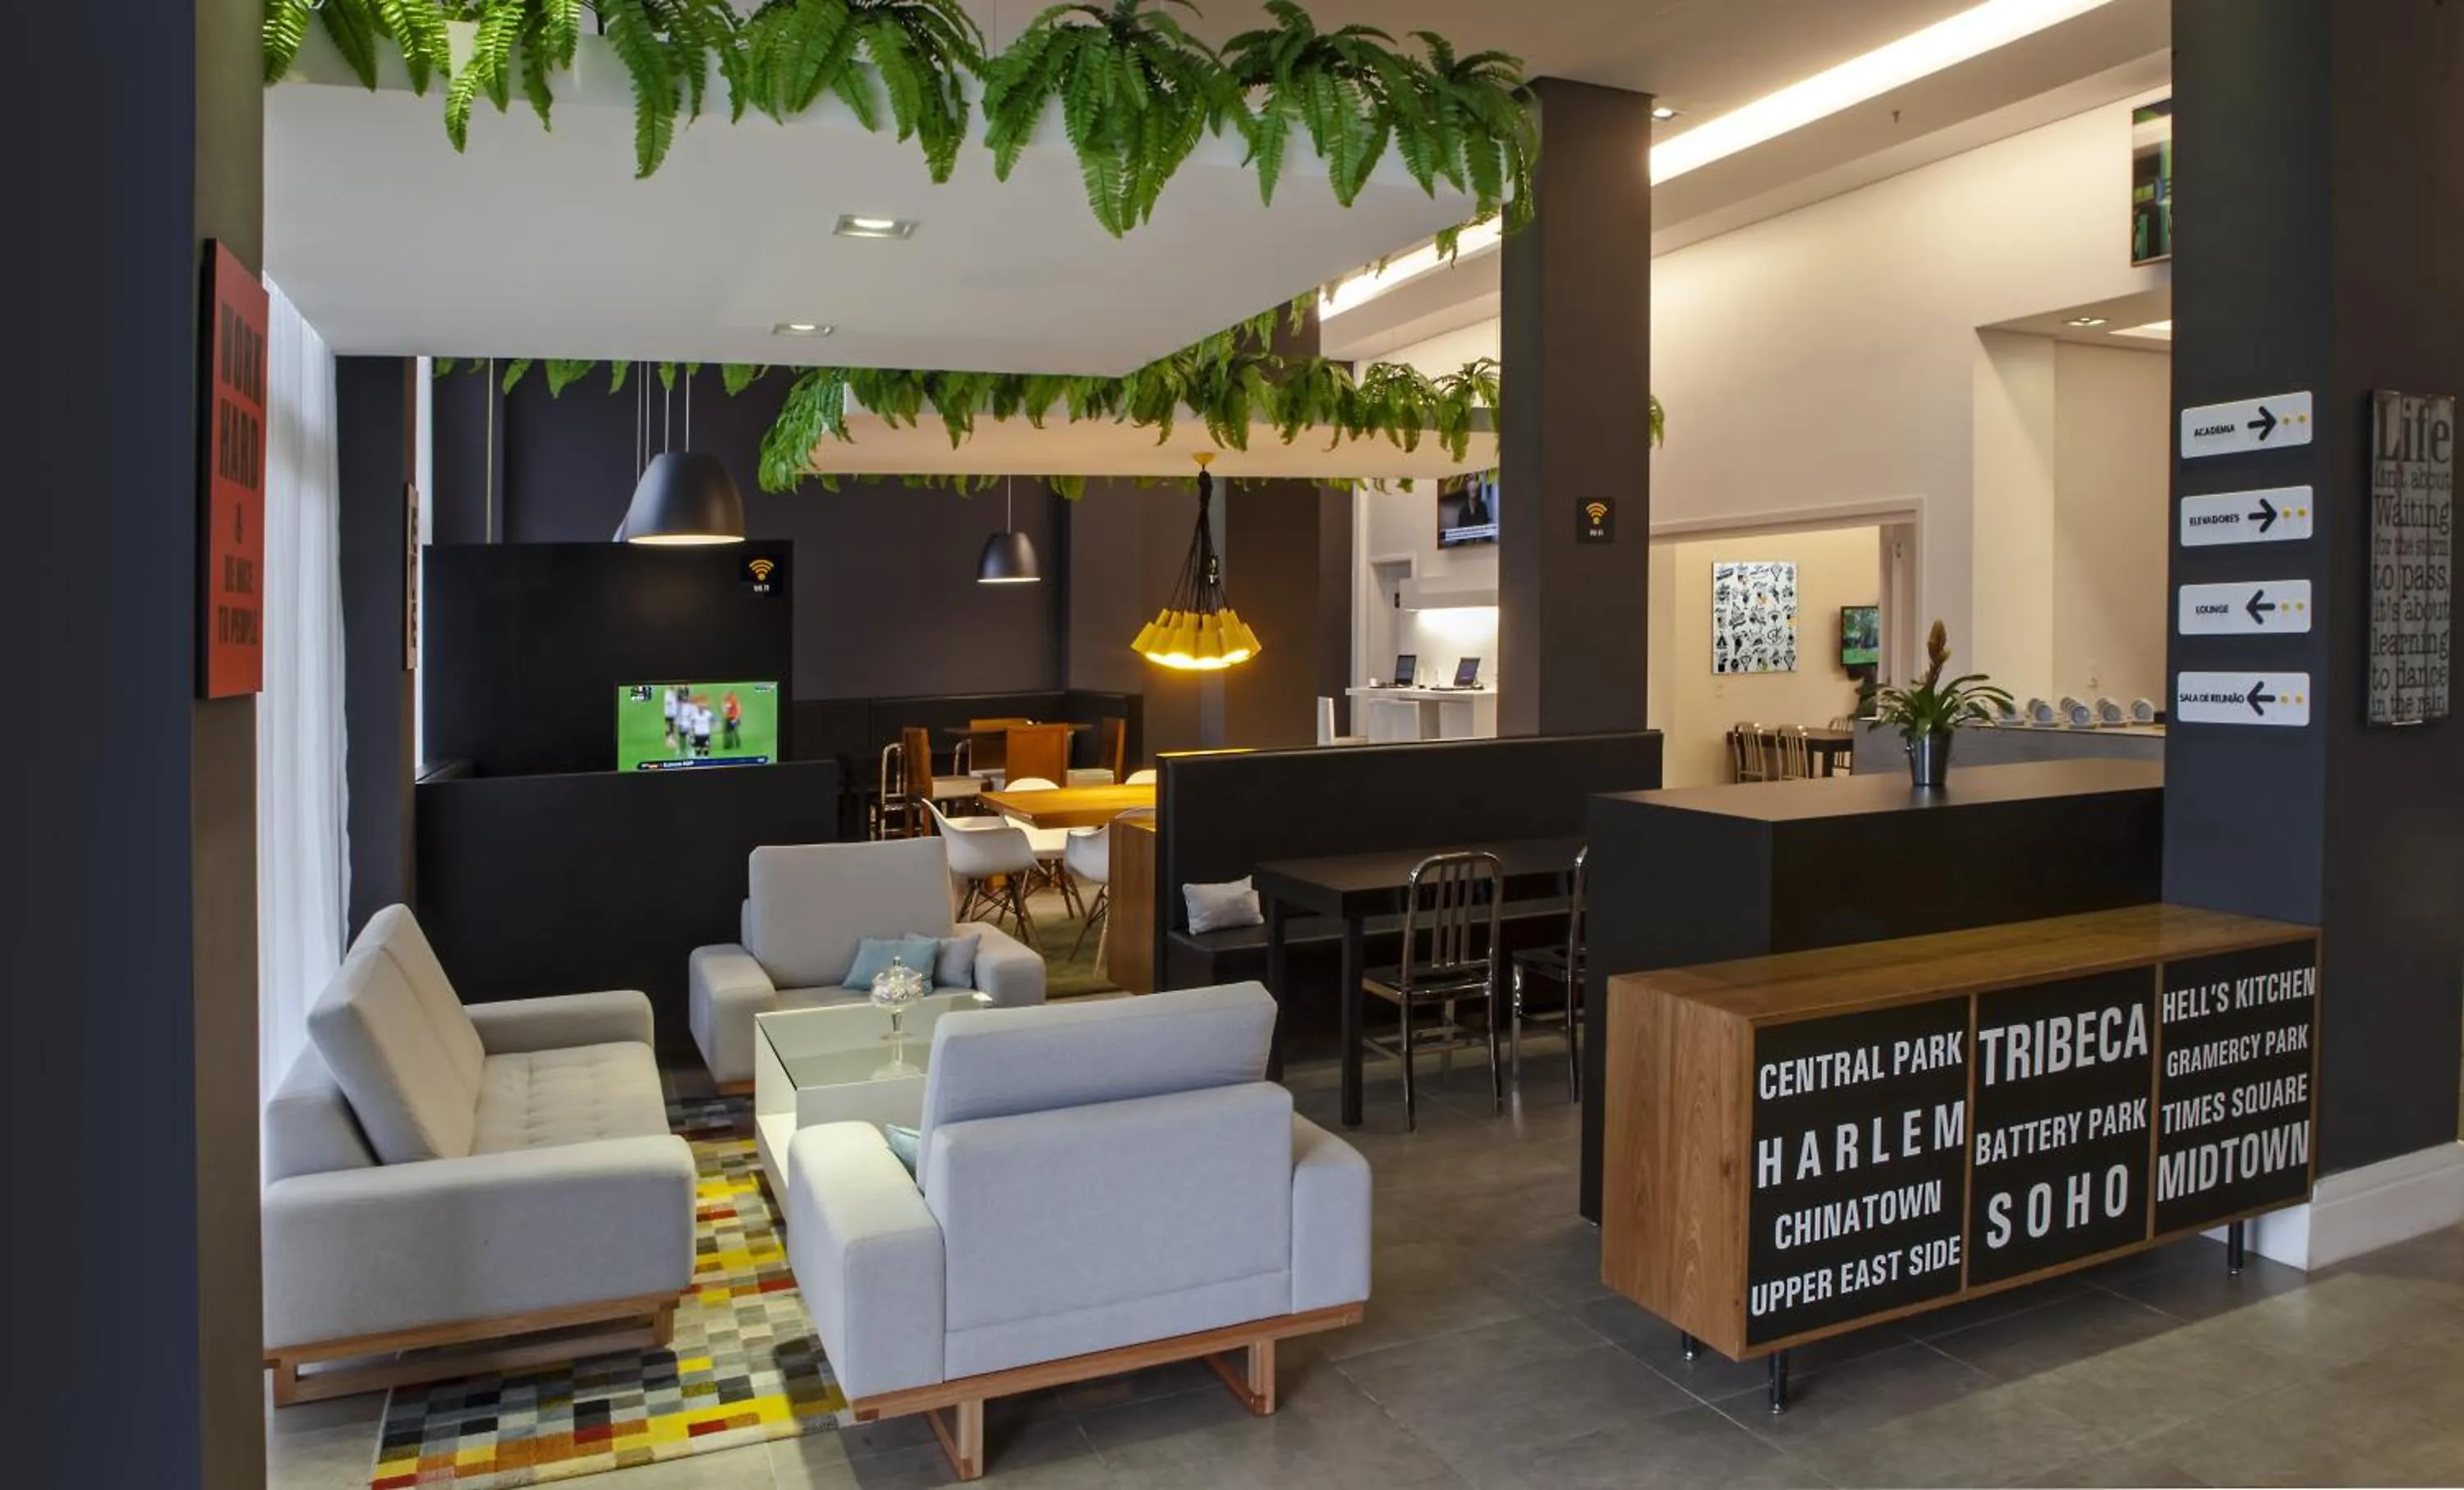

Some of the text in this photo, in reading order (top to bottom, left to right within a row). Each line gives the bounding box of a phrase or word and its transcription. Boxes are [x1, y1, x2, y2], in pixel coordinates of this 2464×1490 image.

[2194, 424, 2235, 439] ACADEMIA
[2375, 396, 2451, 465] Life
[2189, 513, 2240, 527] ELEVADORES
[2374, 494, 2449, 536] Waiting
[2374, 563, 2394, 591] to
[2195, 605, 2228, 615] LOUNGE
[2405, 596, 2449, 622] about
[2371, 628, 2448, 661] learning
[2179, 693, 2199, 703] SALA
[2200, 693, 2209, 703] DE
[2372, 660, 2448, 691] to dance
[2162, 966, 2316, 1024] HELL'S KITCHEN
[1759, 1031, 1964, 1101] CENTRAL PARK
[1979, 1003, 2149, 1087] TRIBECA
[2166, 1023, 2309, 1078] GRAMERCY PARK
[1975, 1097, 2147, 1166] BATTERY PARK
[2161, 1073, 2308, 1135] TIMES SQUARE
[1757, 1100, 1965, 1189] HARLEM
[2157, 1120, 2310, 1203] MIDTOWN
[1774, 1180, 1942, 1250] CHINATOWN
[1986, 1163, 2129, 1249] SOHO
[1750, 1235, 1961, 1317] UPPER EAST SIDE
